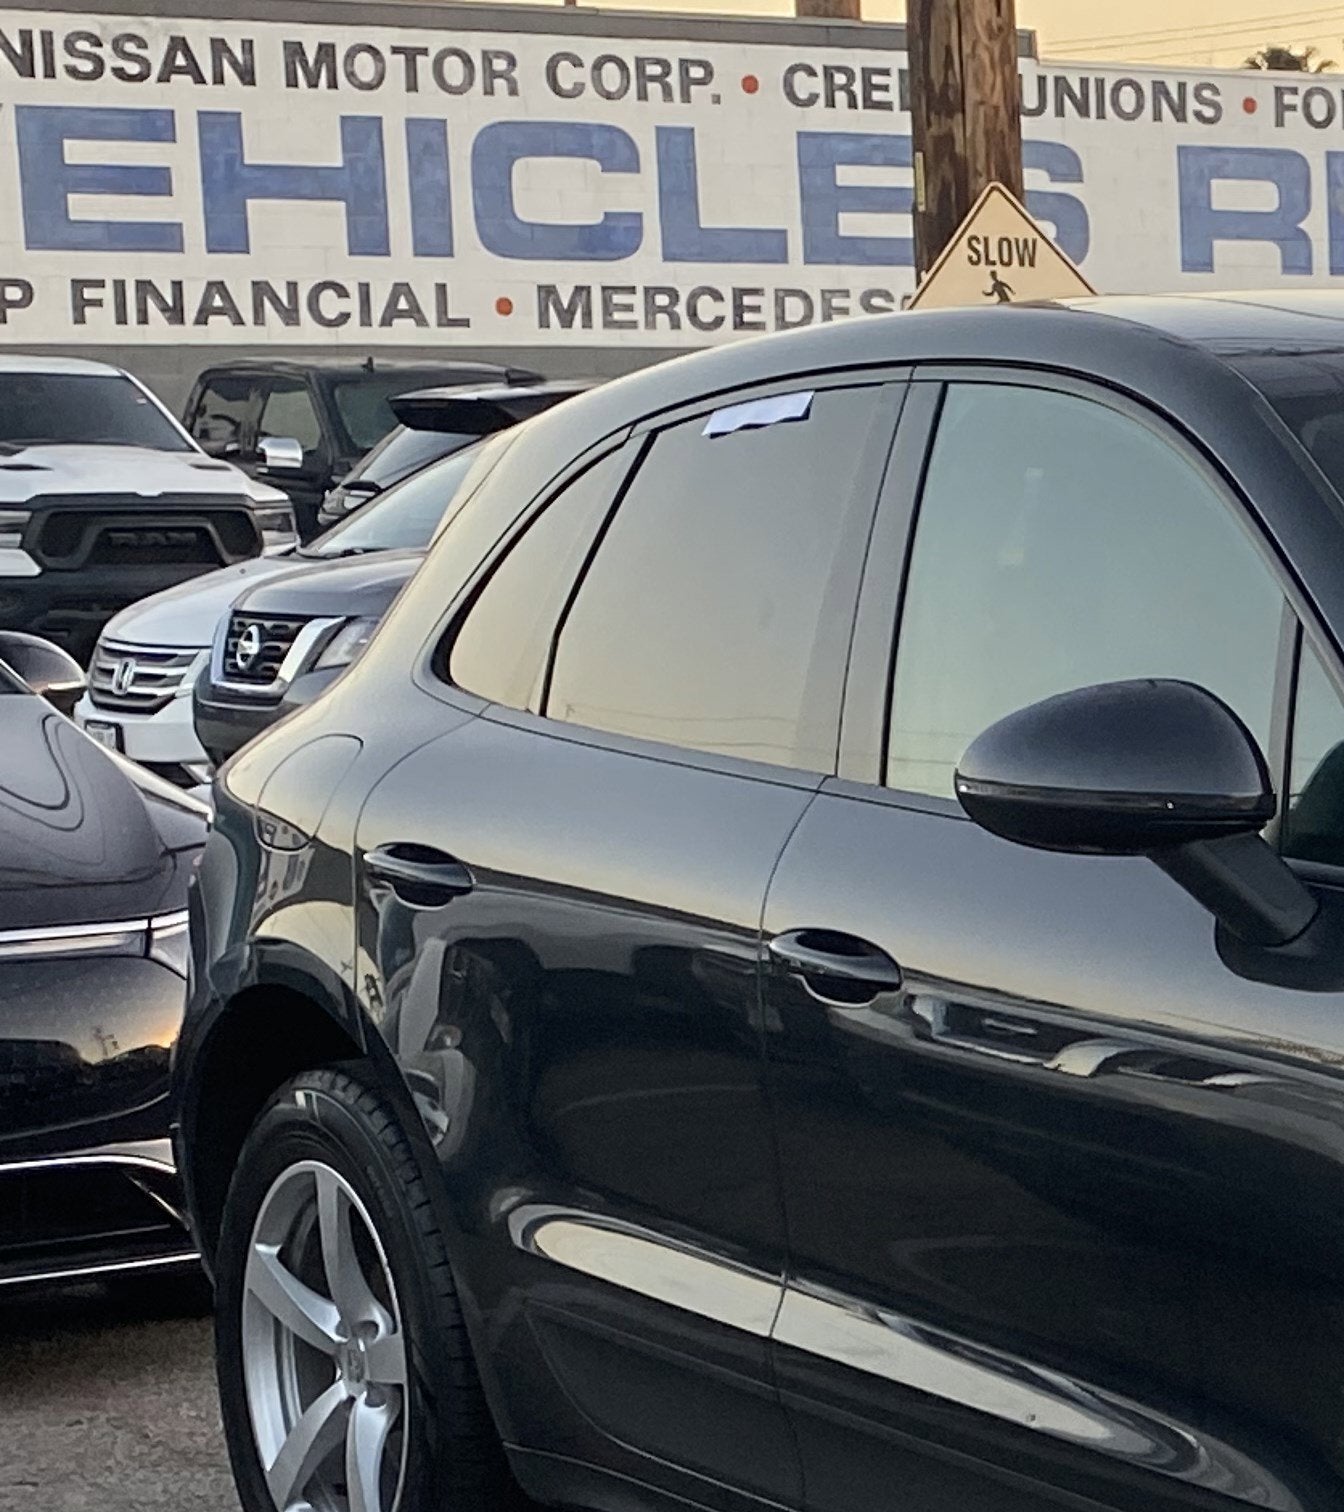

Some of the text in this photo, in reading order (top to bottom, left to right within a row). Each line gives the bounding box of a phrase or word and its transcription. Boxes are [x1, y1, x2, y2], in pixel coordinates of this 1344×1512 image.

[0, 29, 257, 87] NISSAN
[283, 41, 520, 98] MOTOR
[546, 53, 722, 105] CORP.
[783, 63, 911, 112] CRE
[1018, 73, 1222, 126] UNIONS
[0, 104, 1091, 267] EHICLE
[967, 235, 1038, 268] SLOW
[70, 278, 471, 328] FINANCIAL
